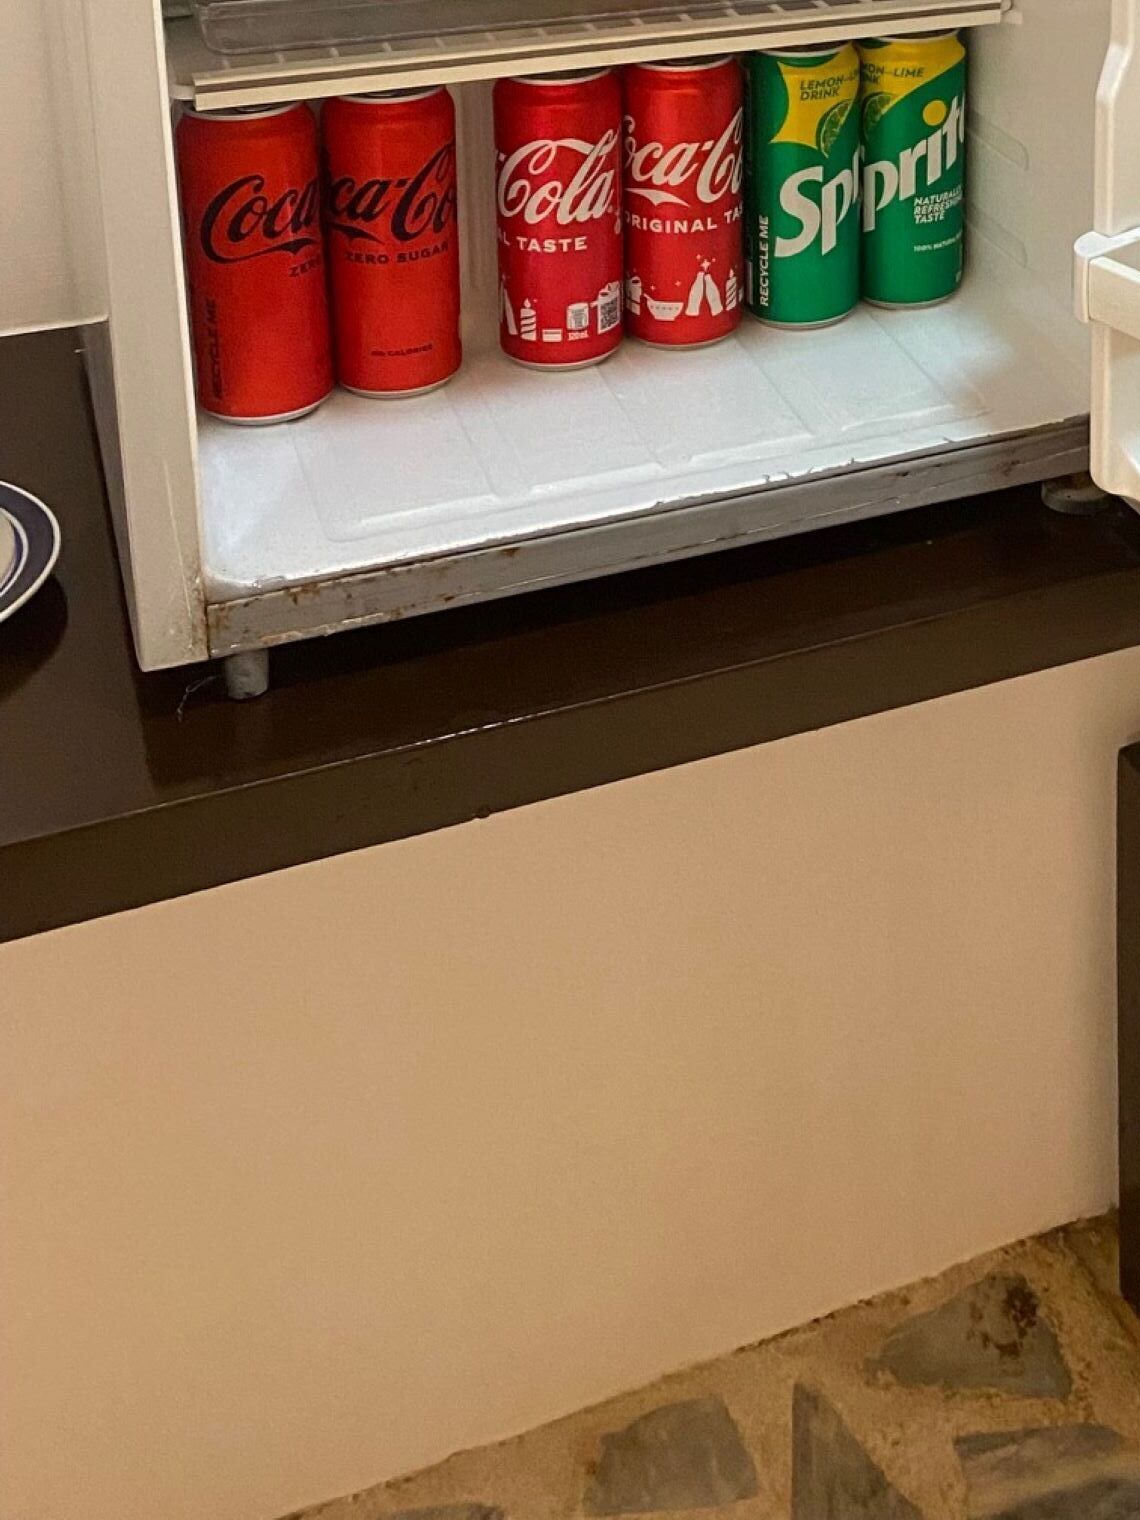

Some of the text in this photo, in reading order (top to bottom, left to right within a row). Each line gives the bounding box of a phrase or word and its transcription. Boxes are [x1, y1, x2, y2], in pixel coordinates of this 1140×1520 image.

[799, 85, 841, 102] DRINK
[914, 210, 946, 224] TASTE
[343, 241, 450, 266] ZERO SUGAR
[515, 234, 588, 255] TASTE
[758, 213, 770, 308] RECYCLE ME
